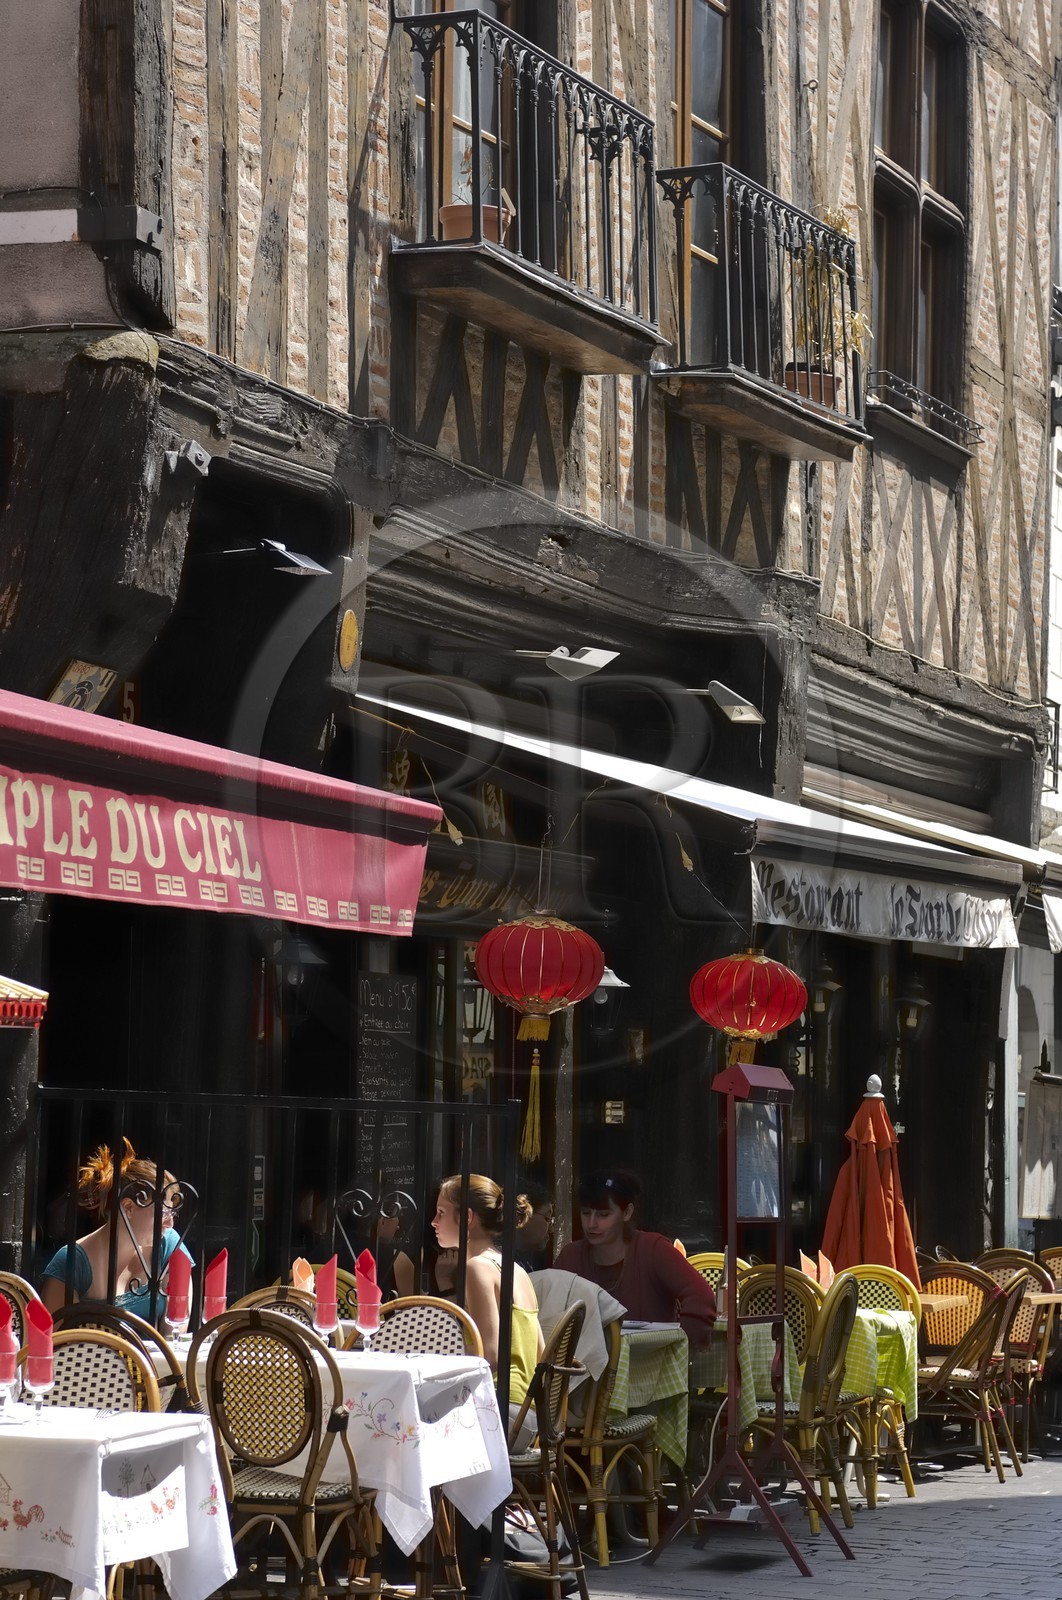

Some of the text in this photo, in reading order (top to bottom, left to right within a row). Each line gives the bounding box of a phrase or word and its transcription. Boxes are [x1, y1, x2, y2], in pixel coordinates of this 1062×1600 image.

[106, 796, 167, 869] DU
[173, 808, 263, 882] CIEL
[359, 979, 385, 1008] Menu
